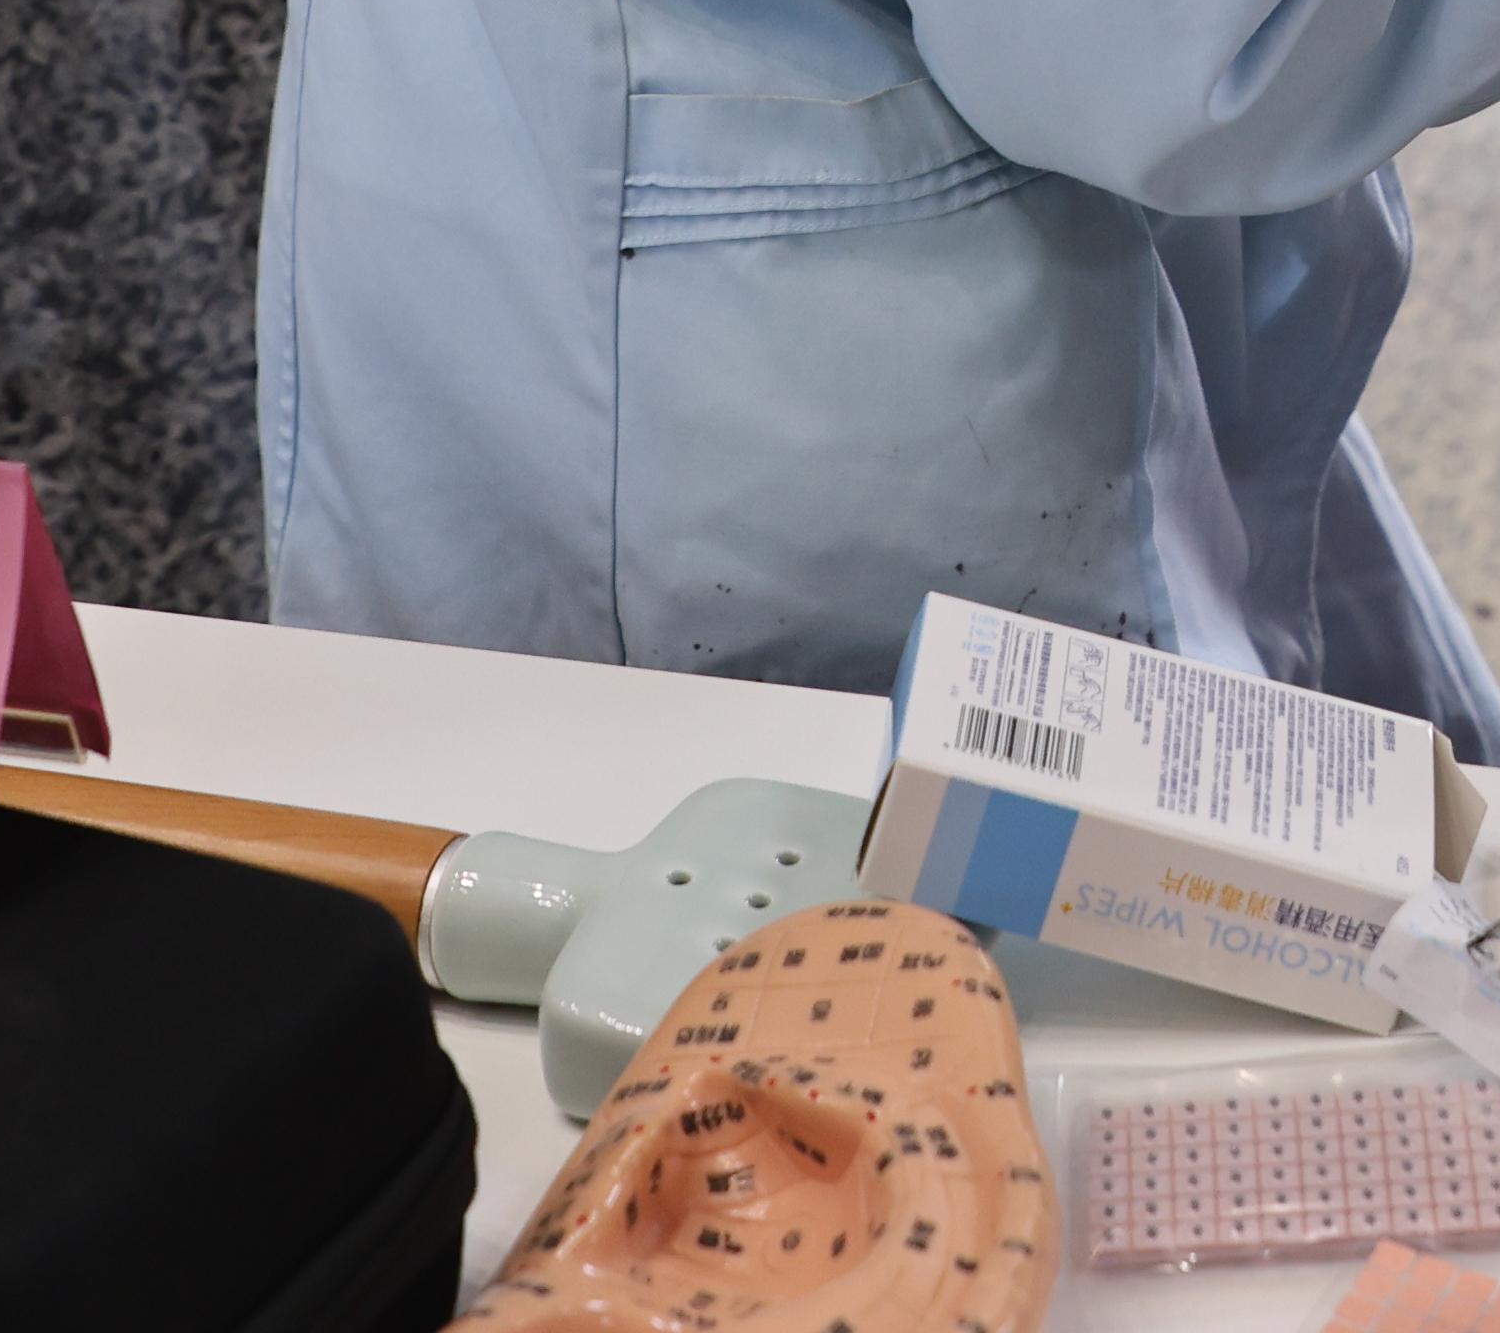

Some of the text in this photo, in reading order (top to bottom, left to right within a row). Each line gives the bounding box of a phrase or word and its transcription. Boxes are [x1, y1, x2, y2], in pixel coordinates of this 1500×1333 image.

[1076, 884, 1186, 938] WIPES
[1161, 870, 1386, 950] 医用酒精消毒棉片
